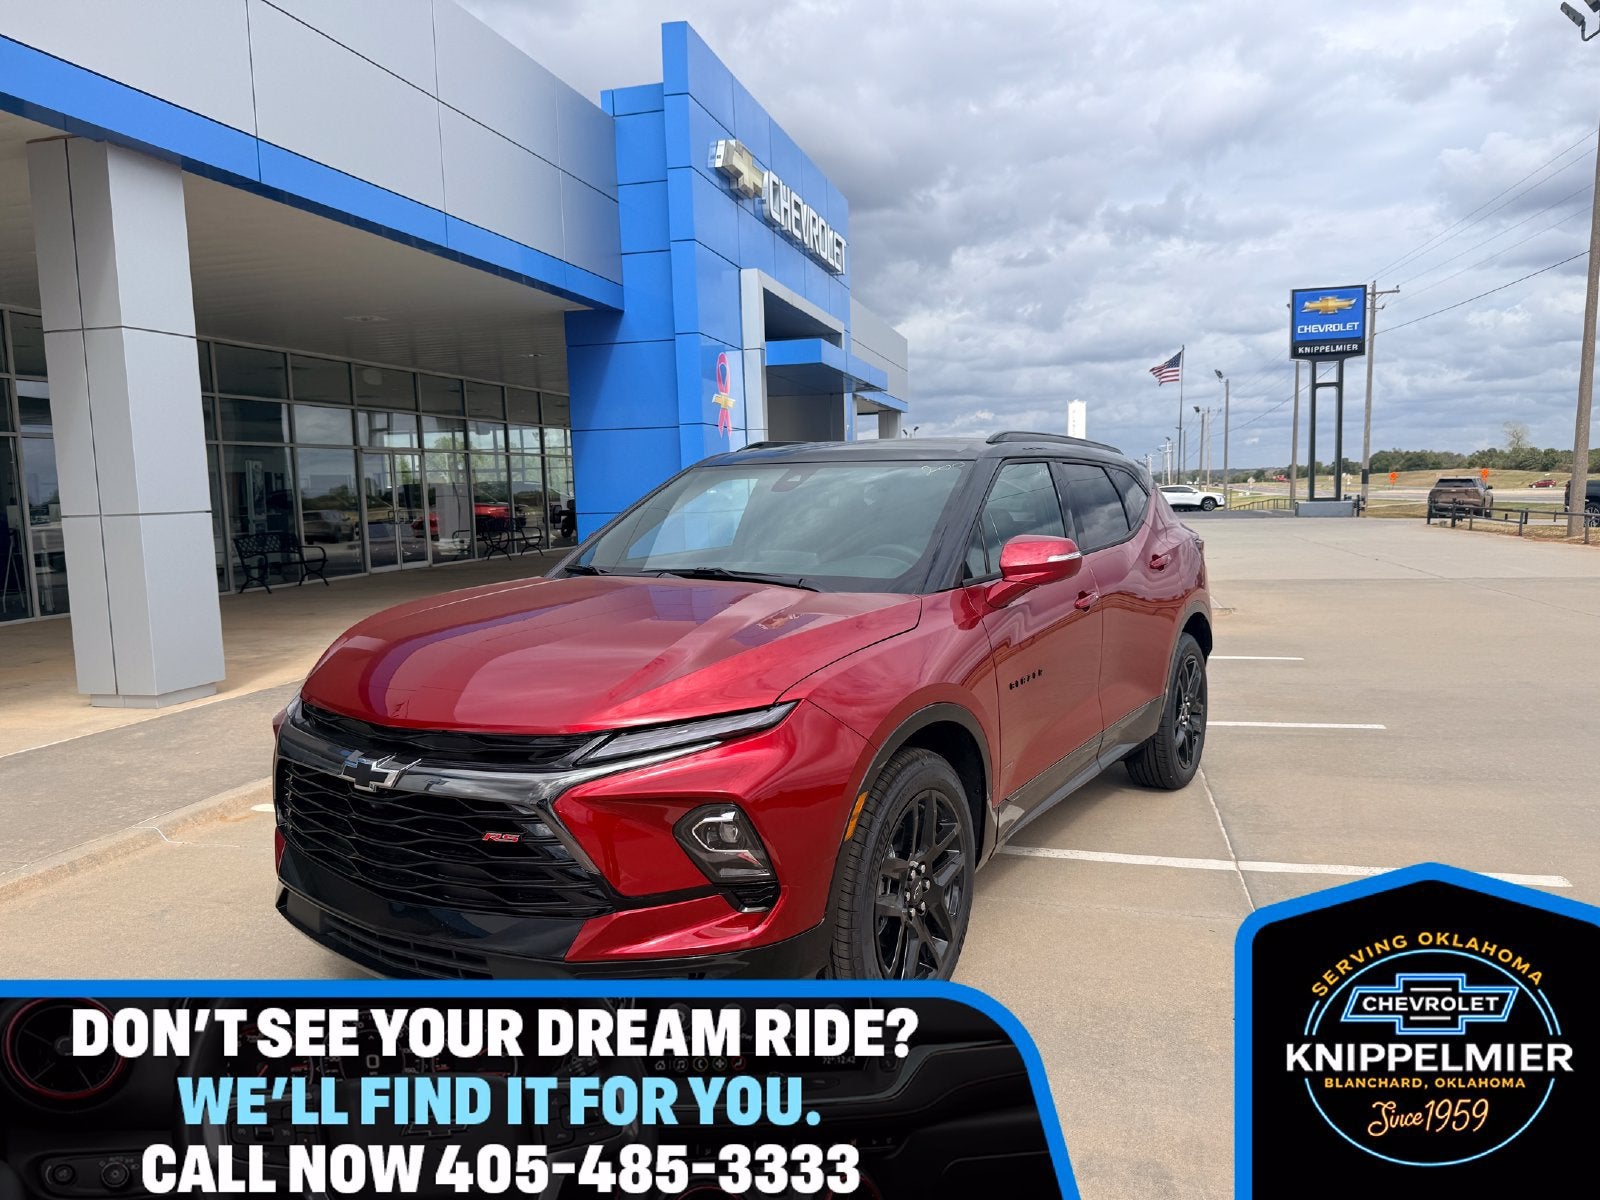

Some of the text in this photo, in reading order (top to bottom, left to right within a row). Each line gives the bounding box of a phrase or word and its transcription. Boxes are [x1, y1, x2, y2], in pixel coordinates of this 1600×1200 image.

[762, 170, 847, 275] CHEVROLET
[1297, 321, 1360, 334] CHEVROLET
[1298, 343, 1359, 354] KNIPPELMIER
[482, 832, 520, 842] RS
